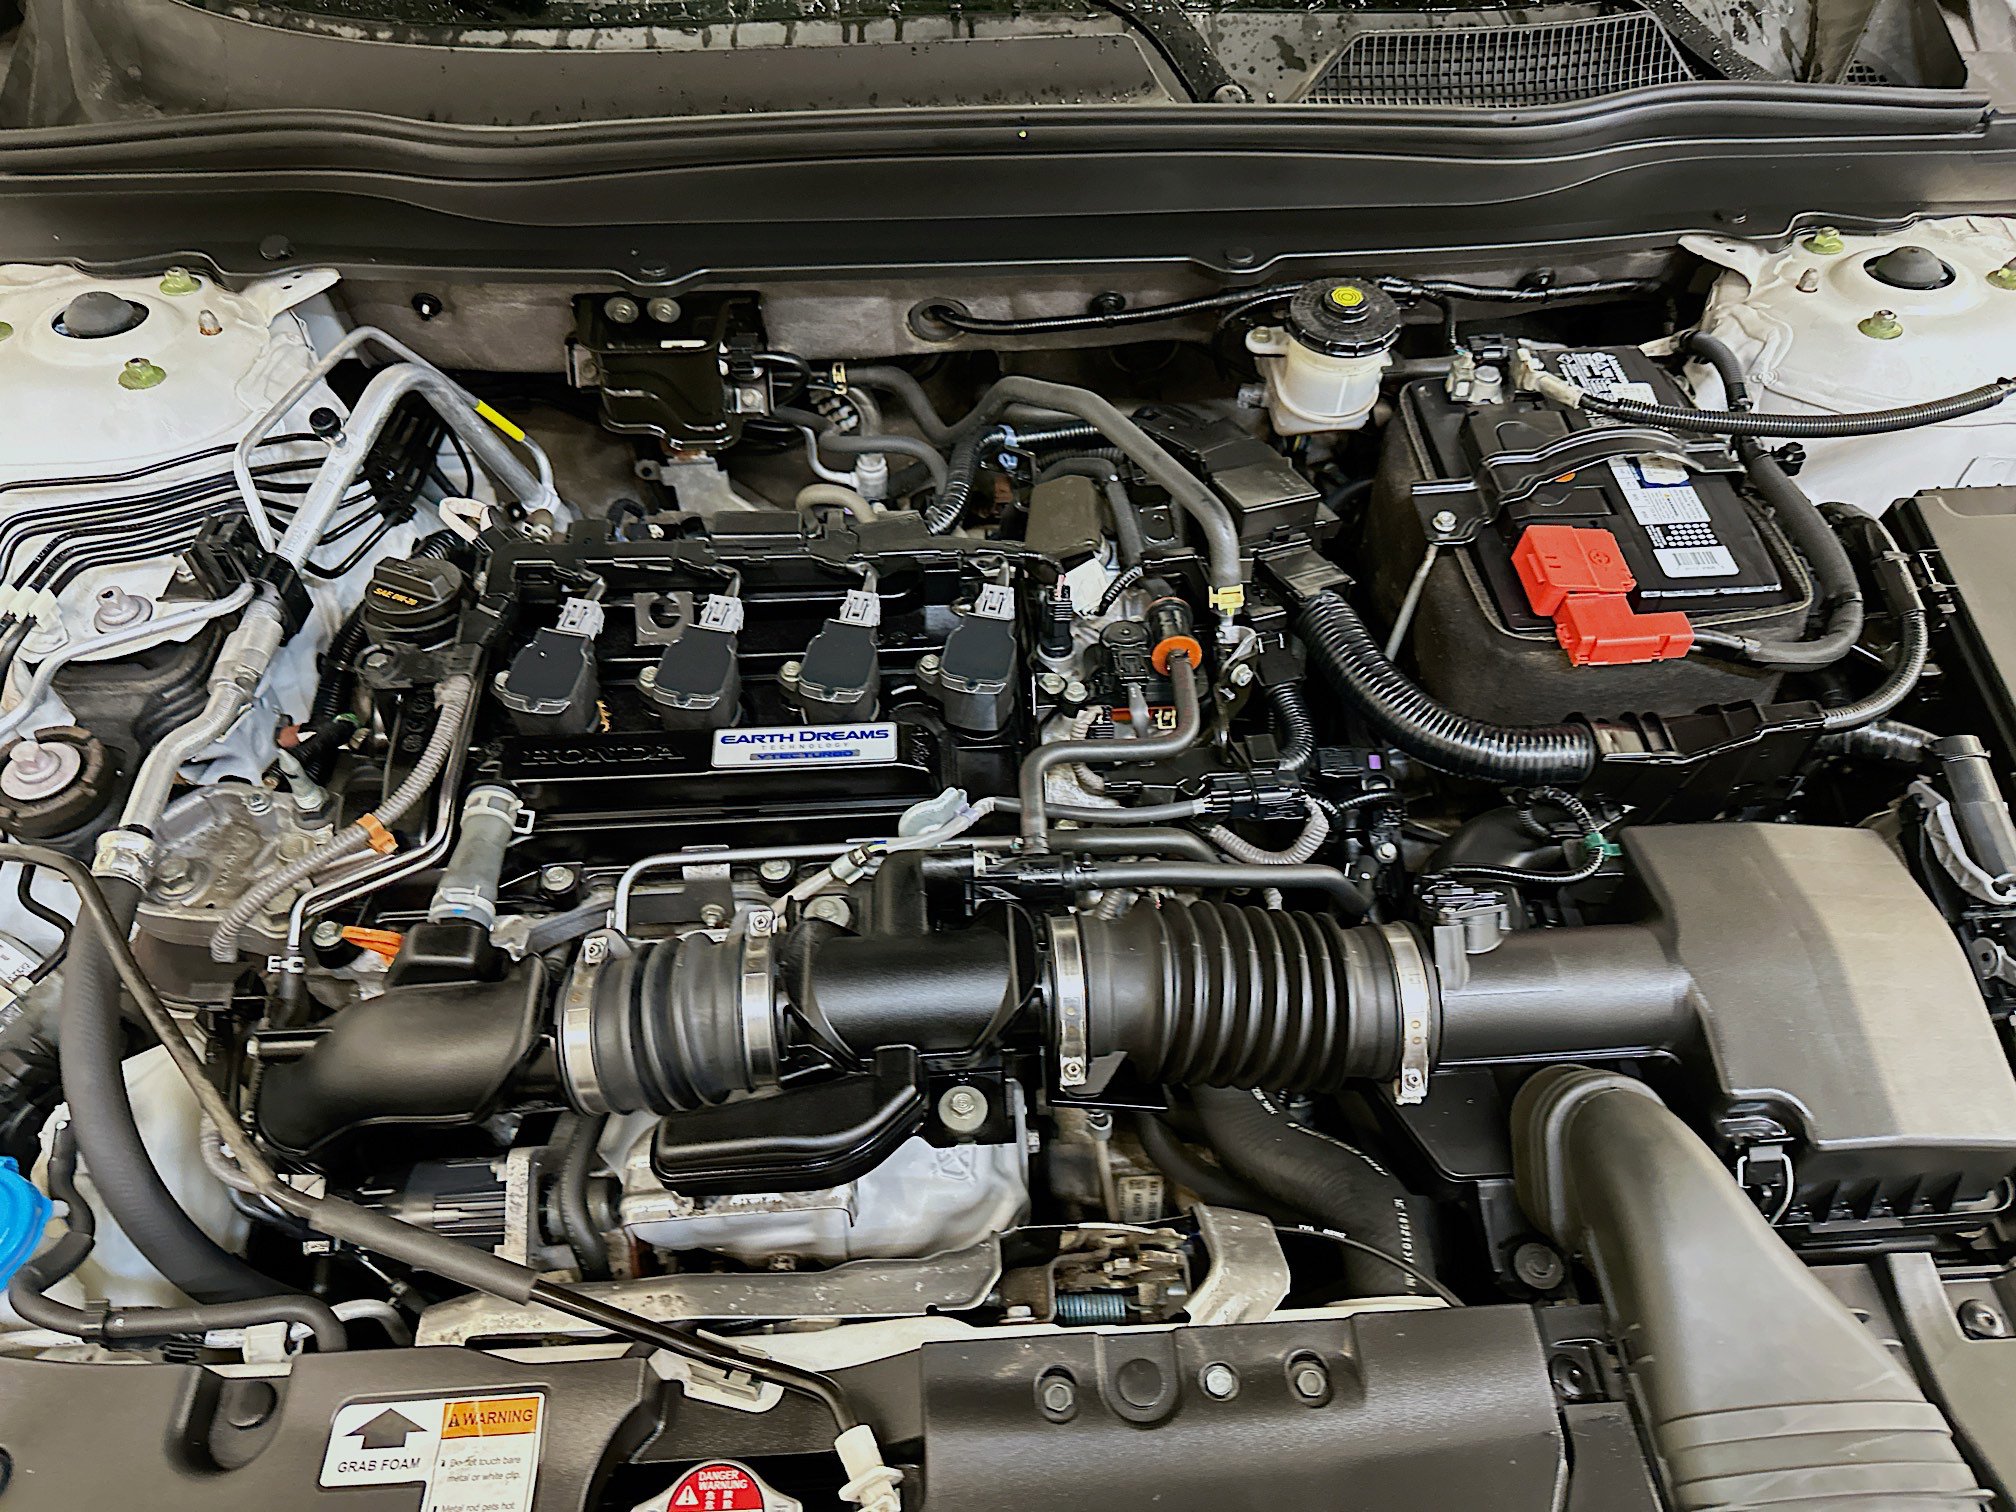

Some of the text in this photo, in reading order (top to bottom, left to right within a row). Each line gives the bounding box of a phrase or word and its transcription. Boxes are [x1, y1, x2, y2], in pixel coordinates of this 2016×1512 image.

[720, 730, 889, 744] EARTH DREAMS
[521, 745, 687, 765] HONDA
[463, 1409, 533, 1425] WARNING
[337, 1457, 420, 1473] GRAB FOAM
[478, 1456, 501, 1466] touch
[503, 1455, 521, 1465] bare
[447, 1472, 470, 1482] metal
[472, 1473, 482, 1481] or
[483, 1470, 503, 1480] white
[698, 1470, 740, 1480] DANGER
[466, 1502, 478, 1511] rod
[501, 1502, 515, 1511] hot
